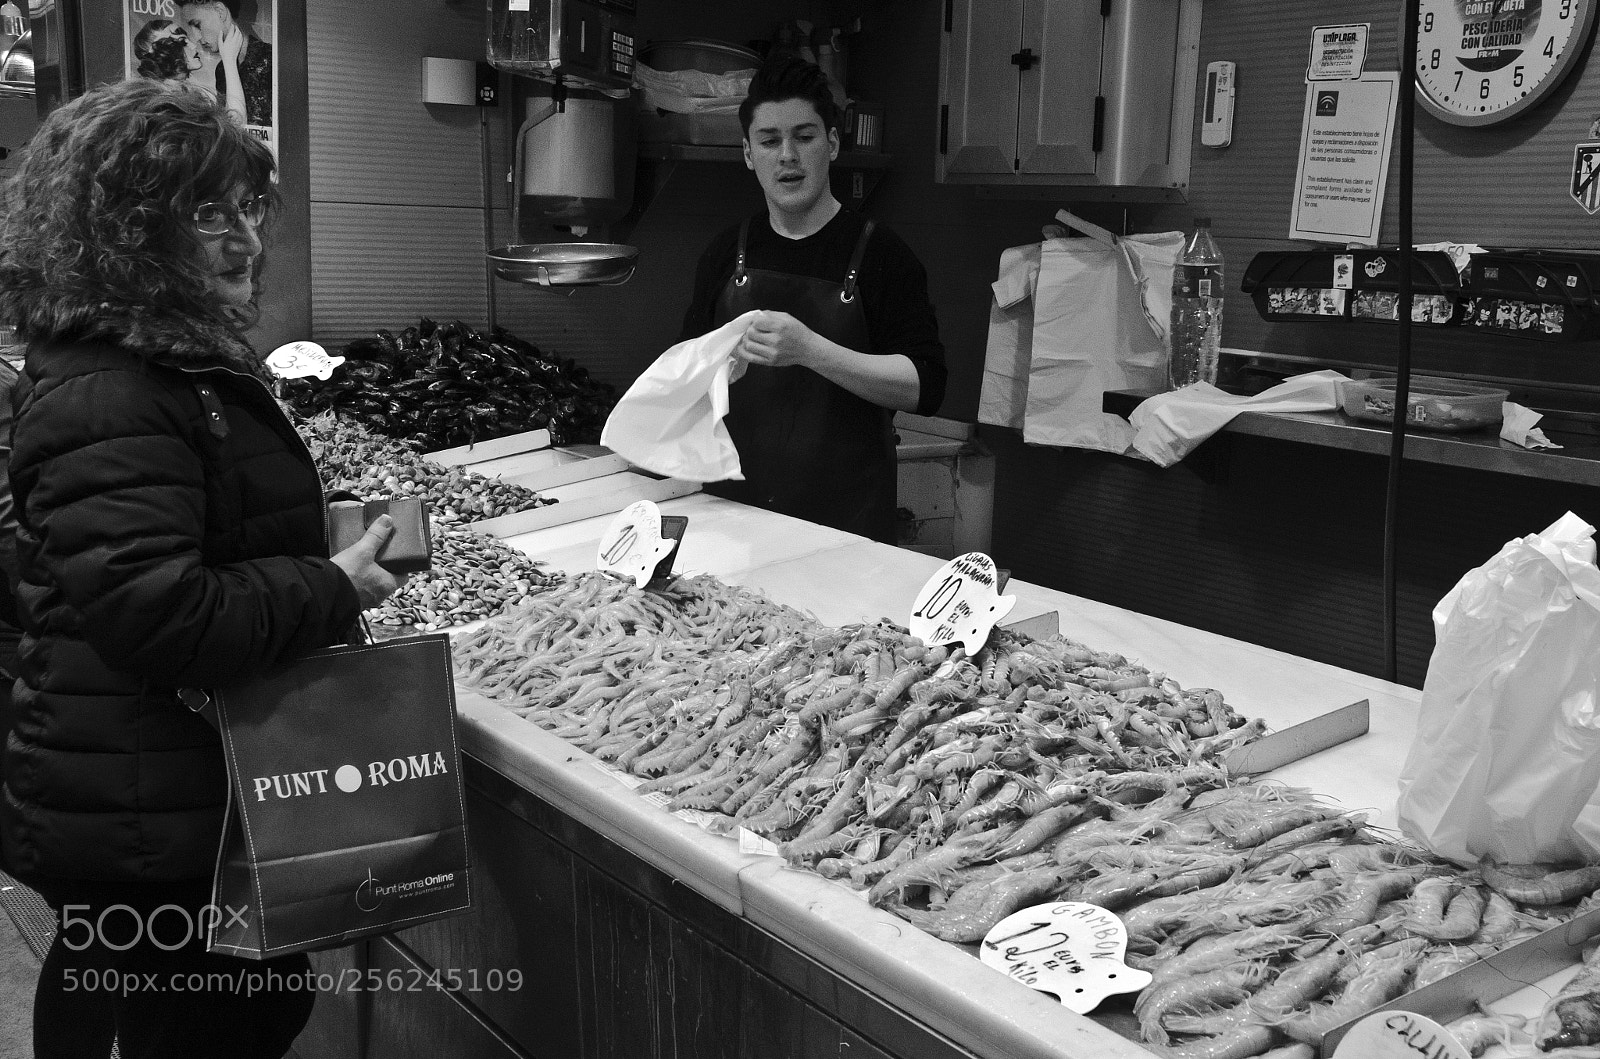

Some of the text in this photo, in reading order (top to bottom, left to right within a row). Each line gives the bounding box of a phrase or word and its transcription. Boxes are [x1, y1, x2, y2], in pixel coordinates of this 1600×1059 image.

[1465, 3, 1483, 15] CON
[1424, 12, 1434, 32] 9
[1461, 33, 1522, 49] CON CALIDAD
[1543, 36, 1555, 58] 4
[1431, 49, 1441, 69] 8
[1454, 71, 1464, 92] 7
[1513, 66, 1525, 87] 5
[1480, 79, 1490, 99] 6
[913, 574, 963, 620] 10
[253, 751, 448, 802] PUNT ROMA
[375, 872, 454, 896] Punt Roma Online
